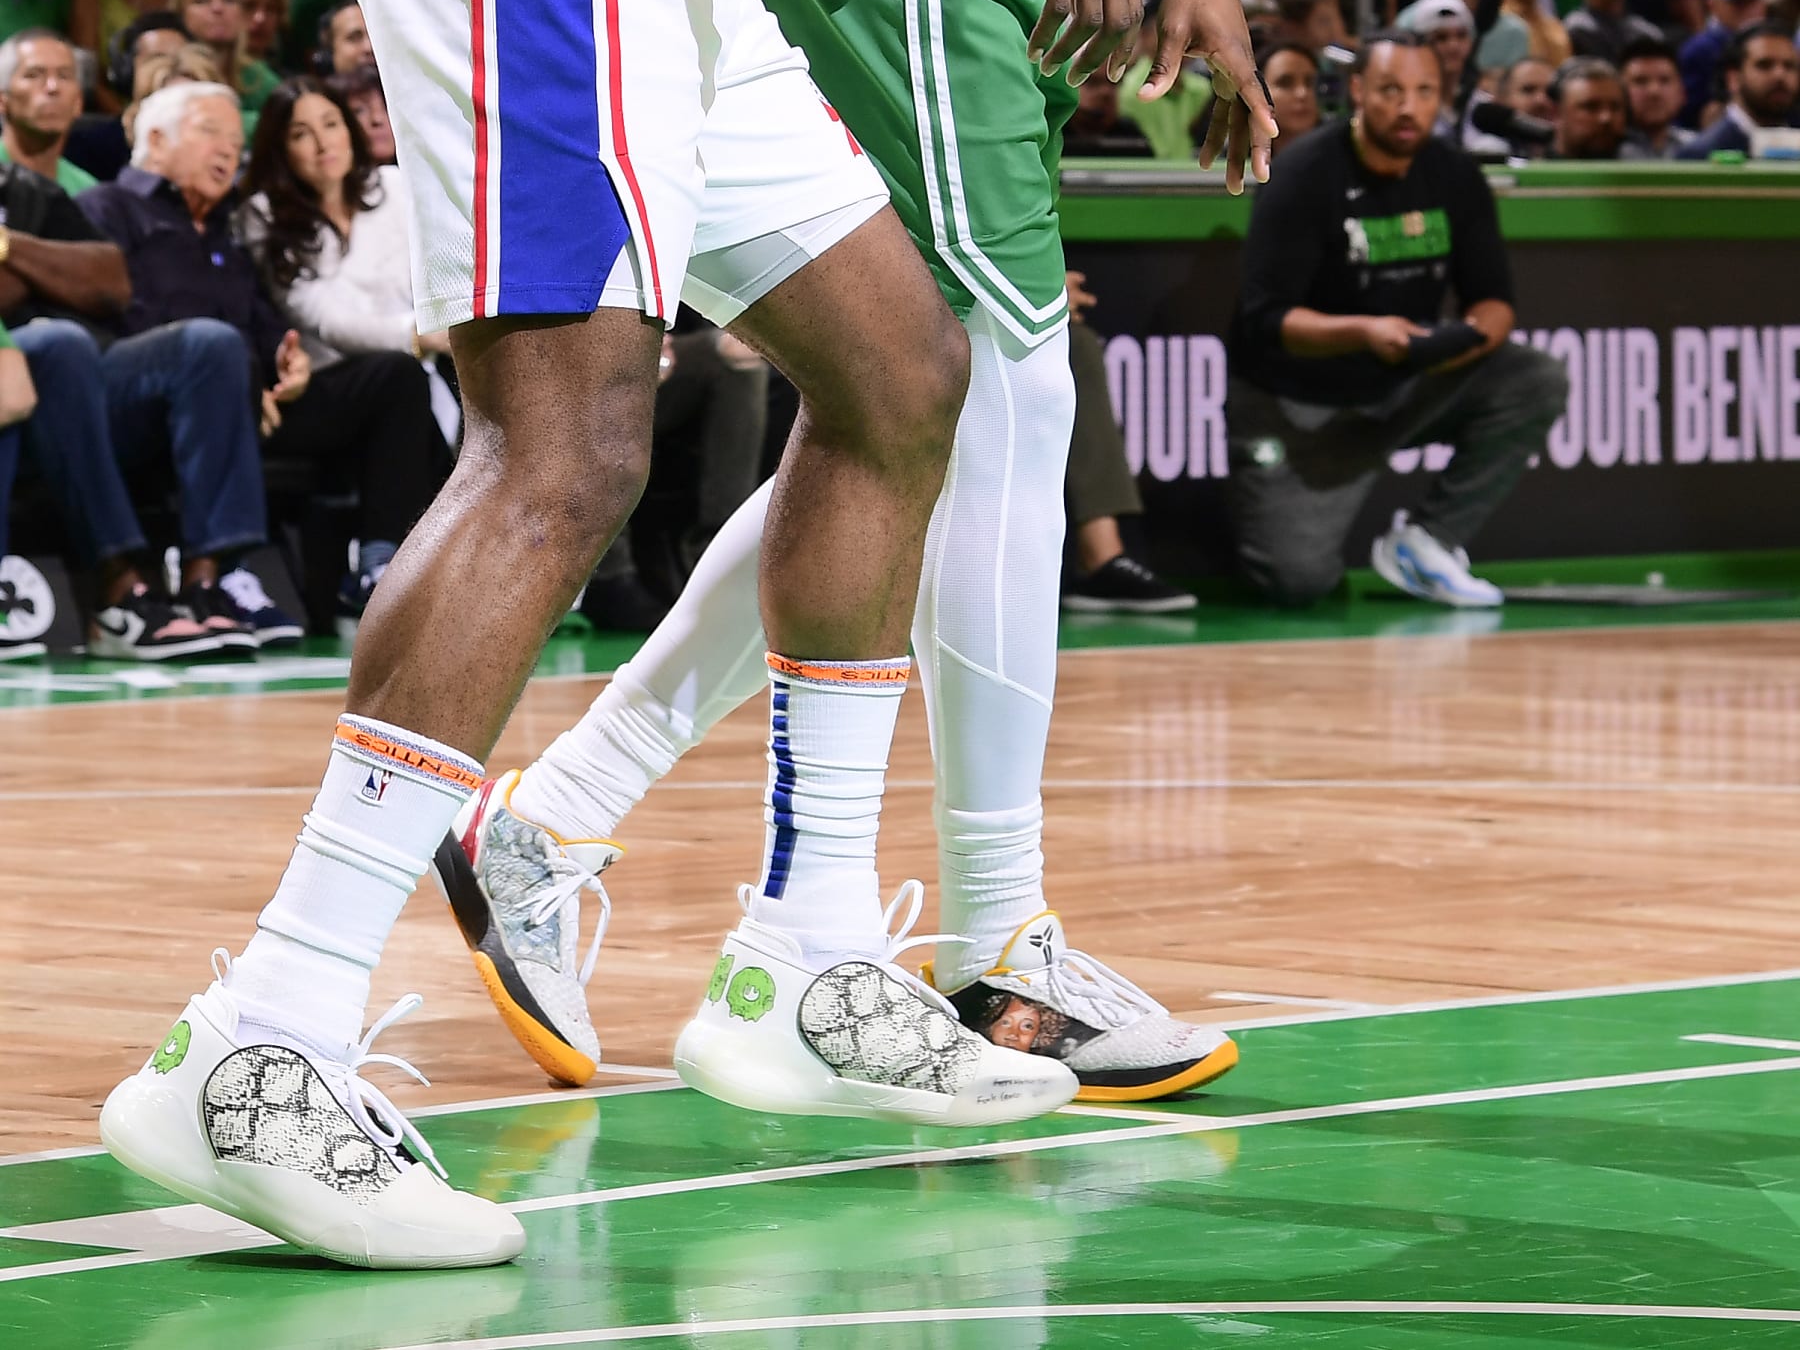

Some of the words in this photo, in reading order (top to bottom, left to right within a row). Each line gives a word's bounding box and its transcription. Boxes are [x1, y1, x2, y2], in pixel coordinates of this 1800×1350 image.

[1099, 334, 1229, 481] OUR
[1509, 327, 1662, 469] OUR
[1672, 325, 1800, 464] BENE
